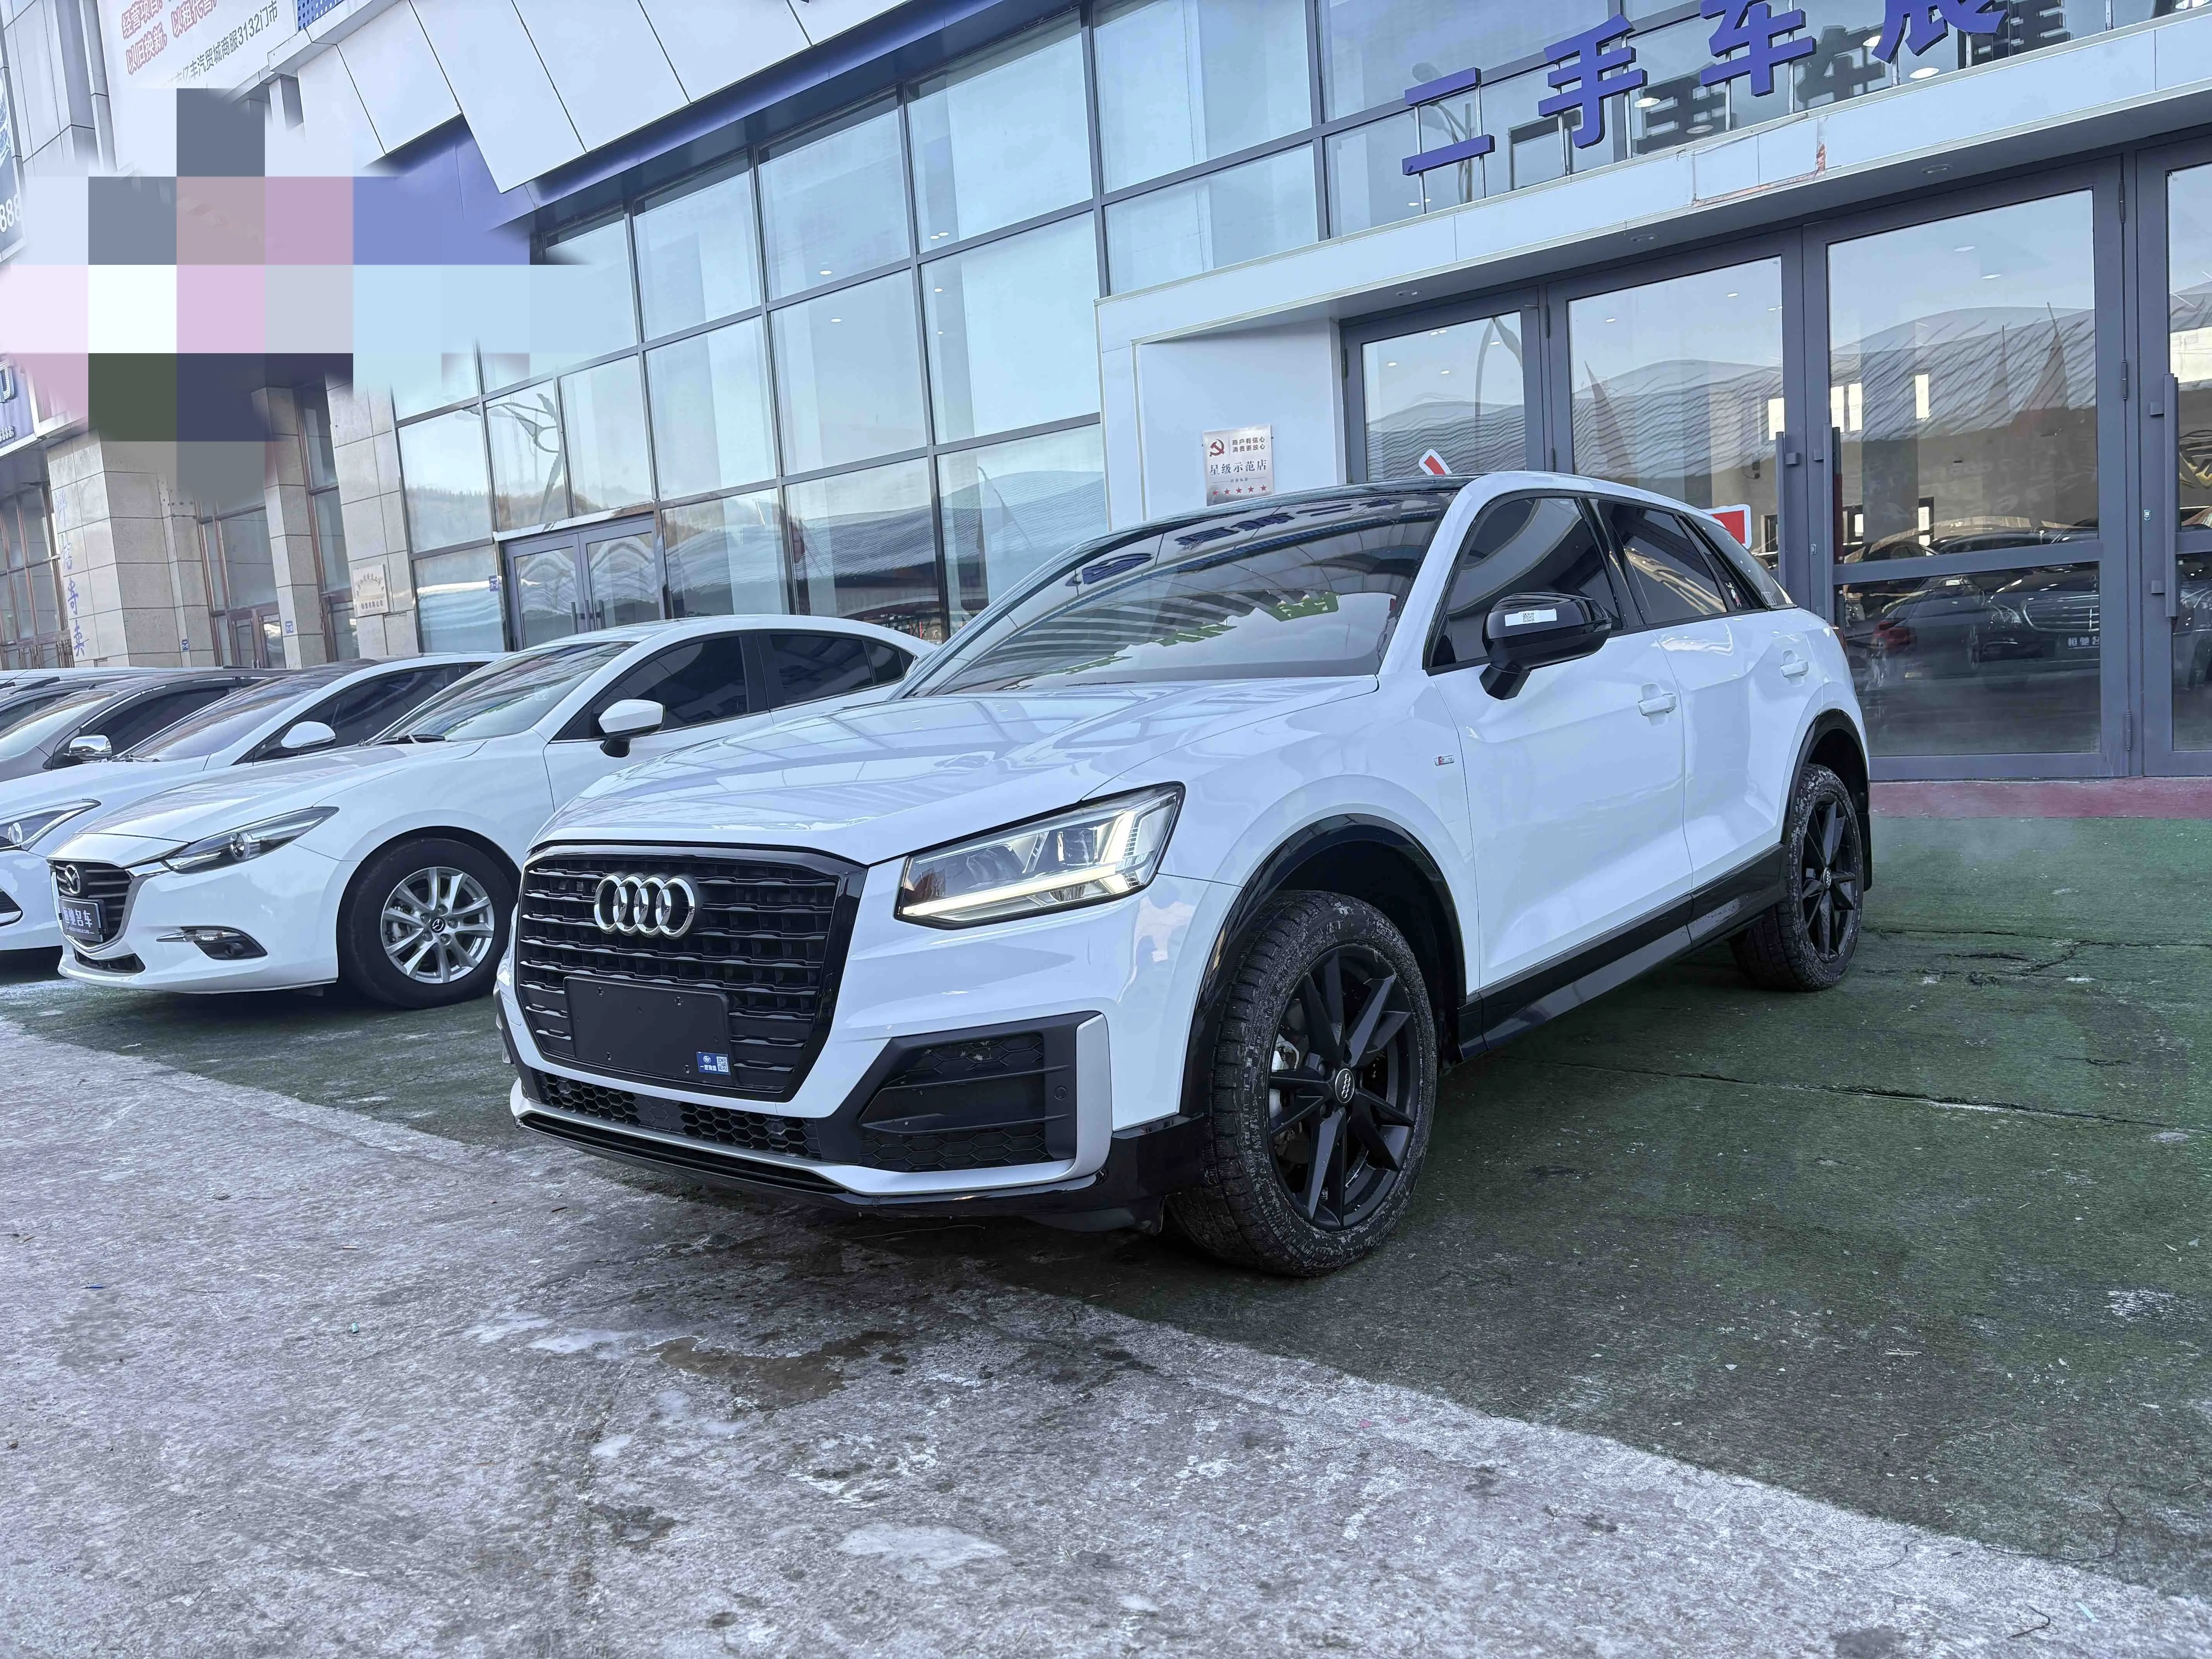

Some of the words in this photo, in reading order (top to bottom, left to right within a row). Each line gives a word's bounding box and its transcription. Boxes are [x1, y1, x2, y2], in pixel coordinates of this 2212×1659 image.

[1232, 436, 1265, 446] 商户有信心
[1232, 444, 1265, 453] 消费更放心
[1209, 459, 1267, 476] 星级示范店
